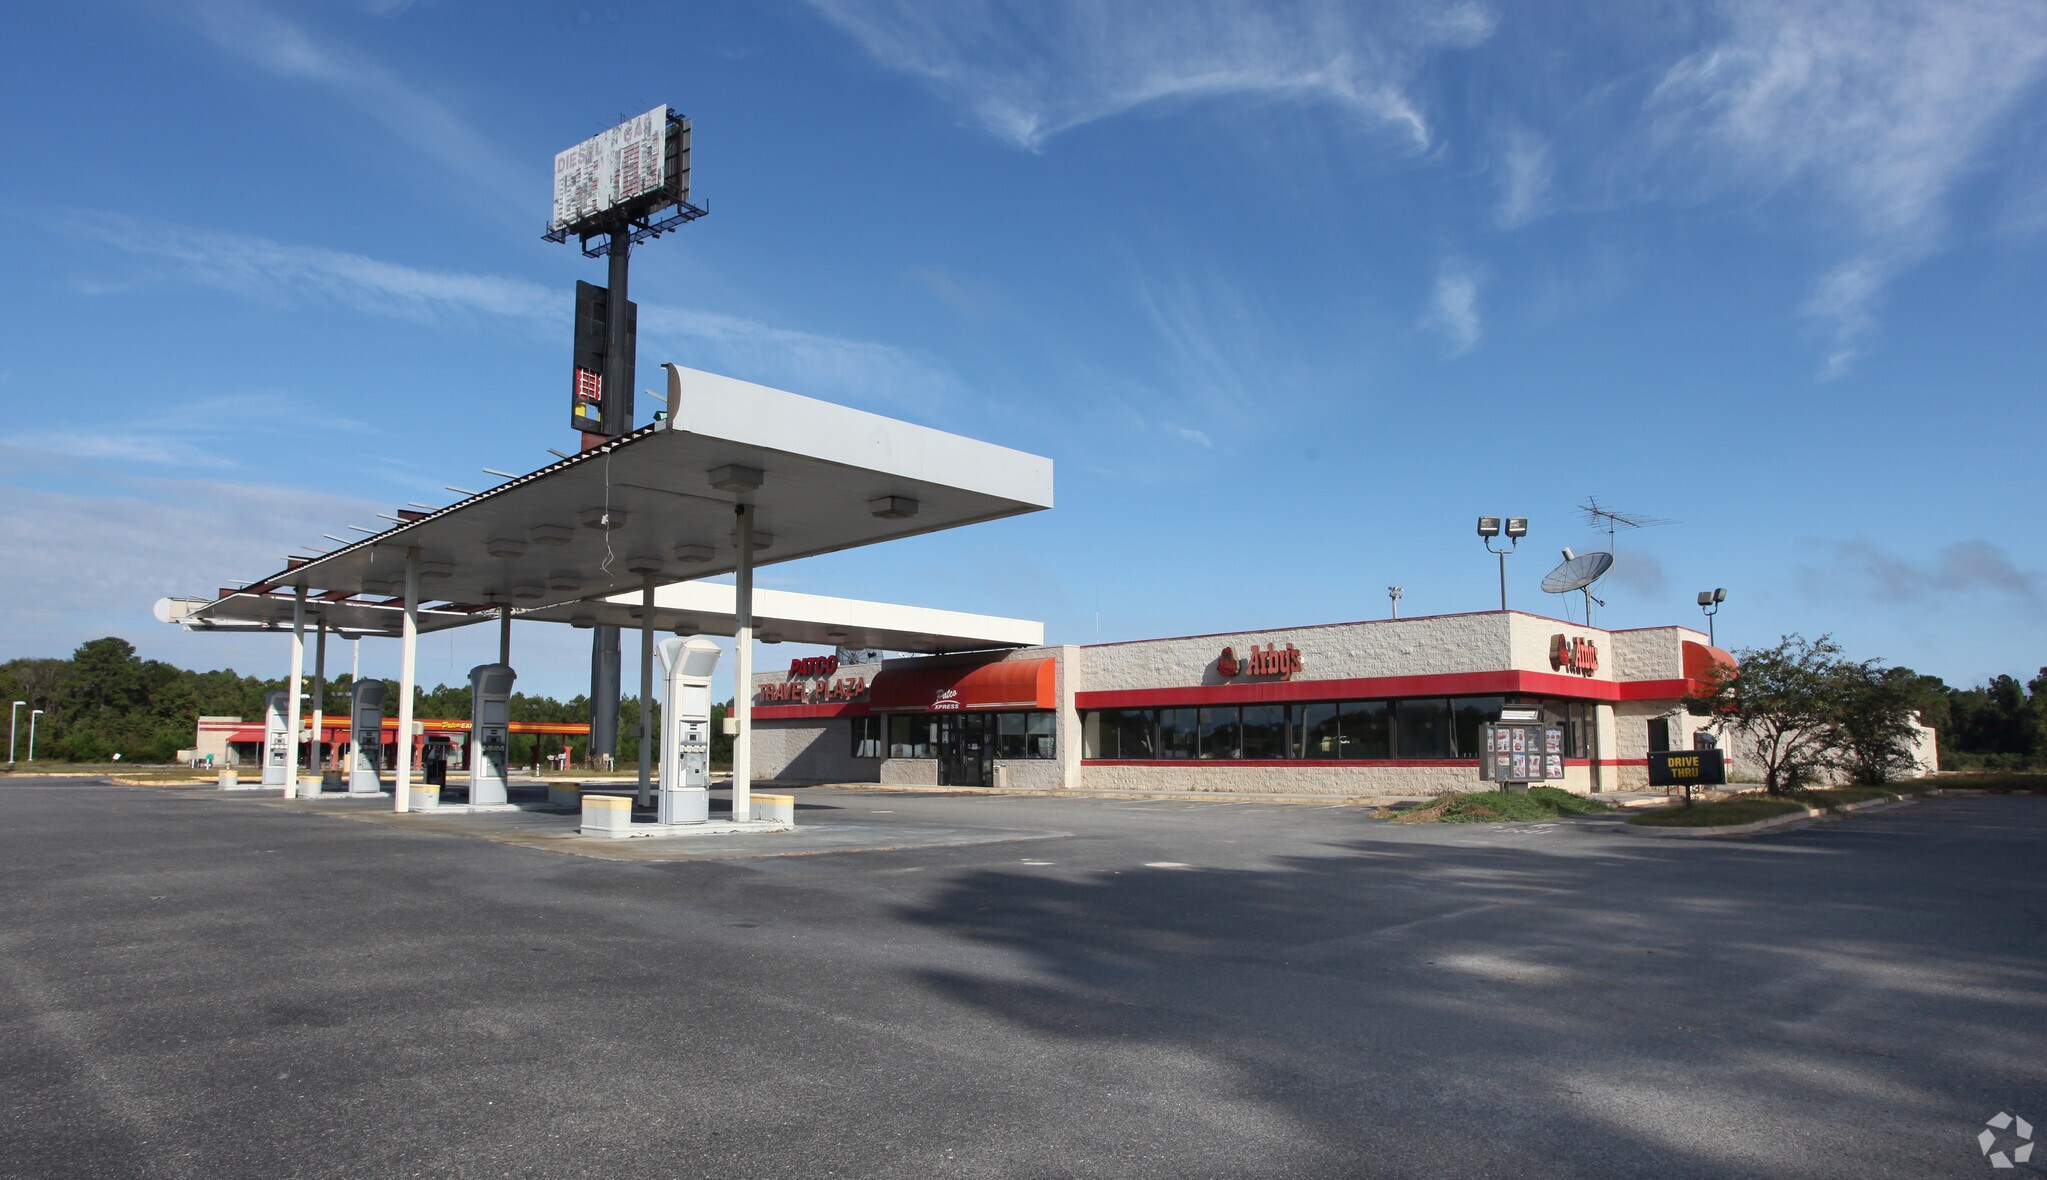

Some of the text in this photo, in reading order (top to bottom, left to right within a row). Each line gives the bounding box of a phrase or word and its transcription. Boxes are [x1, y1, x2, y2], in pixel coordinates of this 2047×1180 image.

[789, 655, 838, 676] PATCO
[1246, 643, 1302, 681] Arby's
[758, 677, 866, 701] TRAVEL PLAZA
[936, 689, 958, 702] Patco
[1668, 757, 1699, 768] DRIVE
[1671, 768, 1699, 778] THRU
